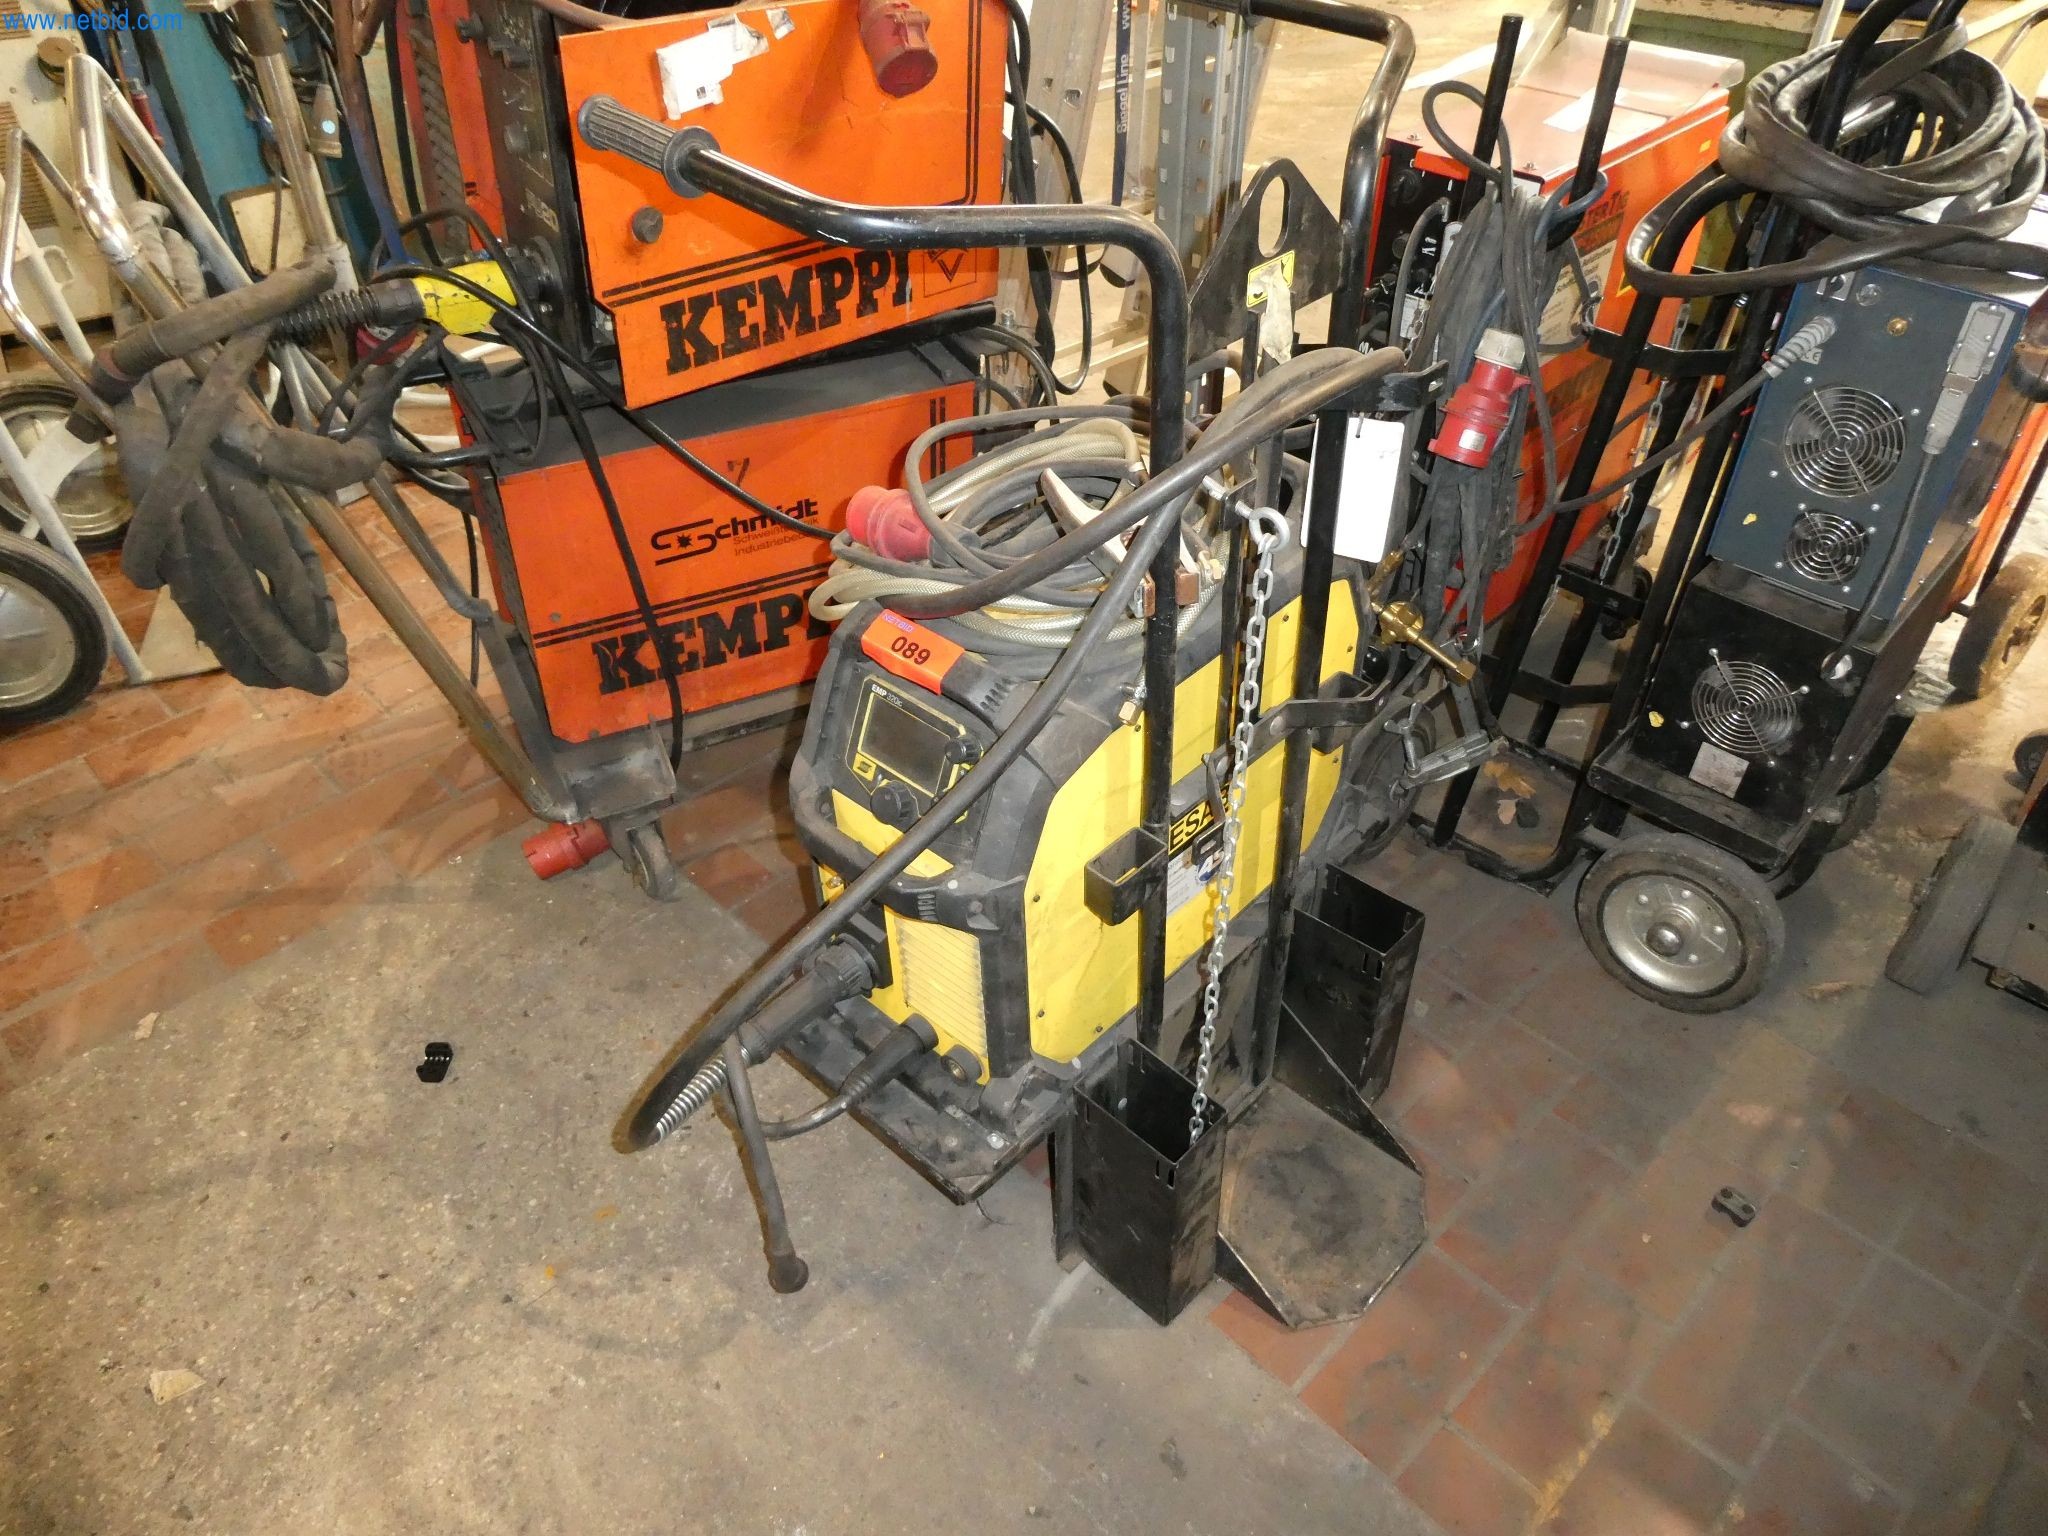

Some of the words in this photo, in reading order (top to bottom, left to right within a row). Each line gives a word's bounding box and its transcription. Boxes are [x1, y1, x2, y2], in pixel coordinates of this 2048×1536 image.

[660, 248, 912, 376] KEMPPI
[891, 636, 931, 665] 089
[871, 684, 887, 697] EMP
